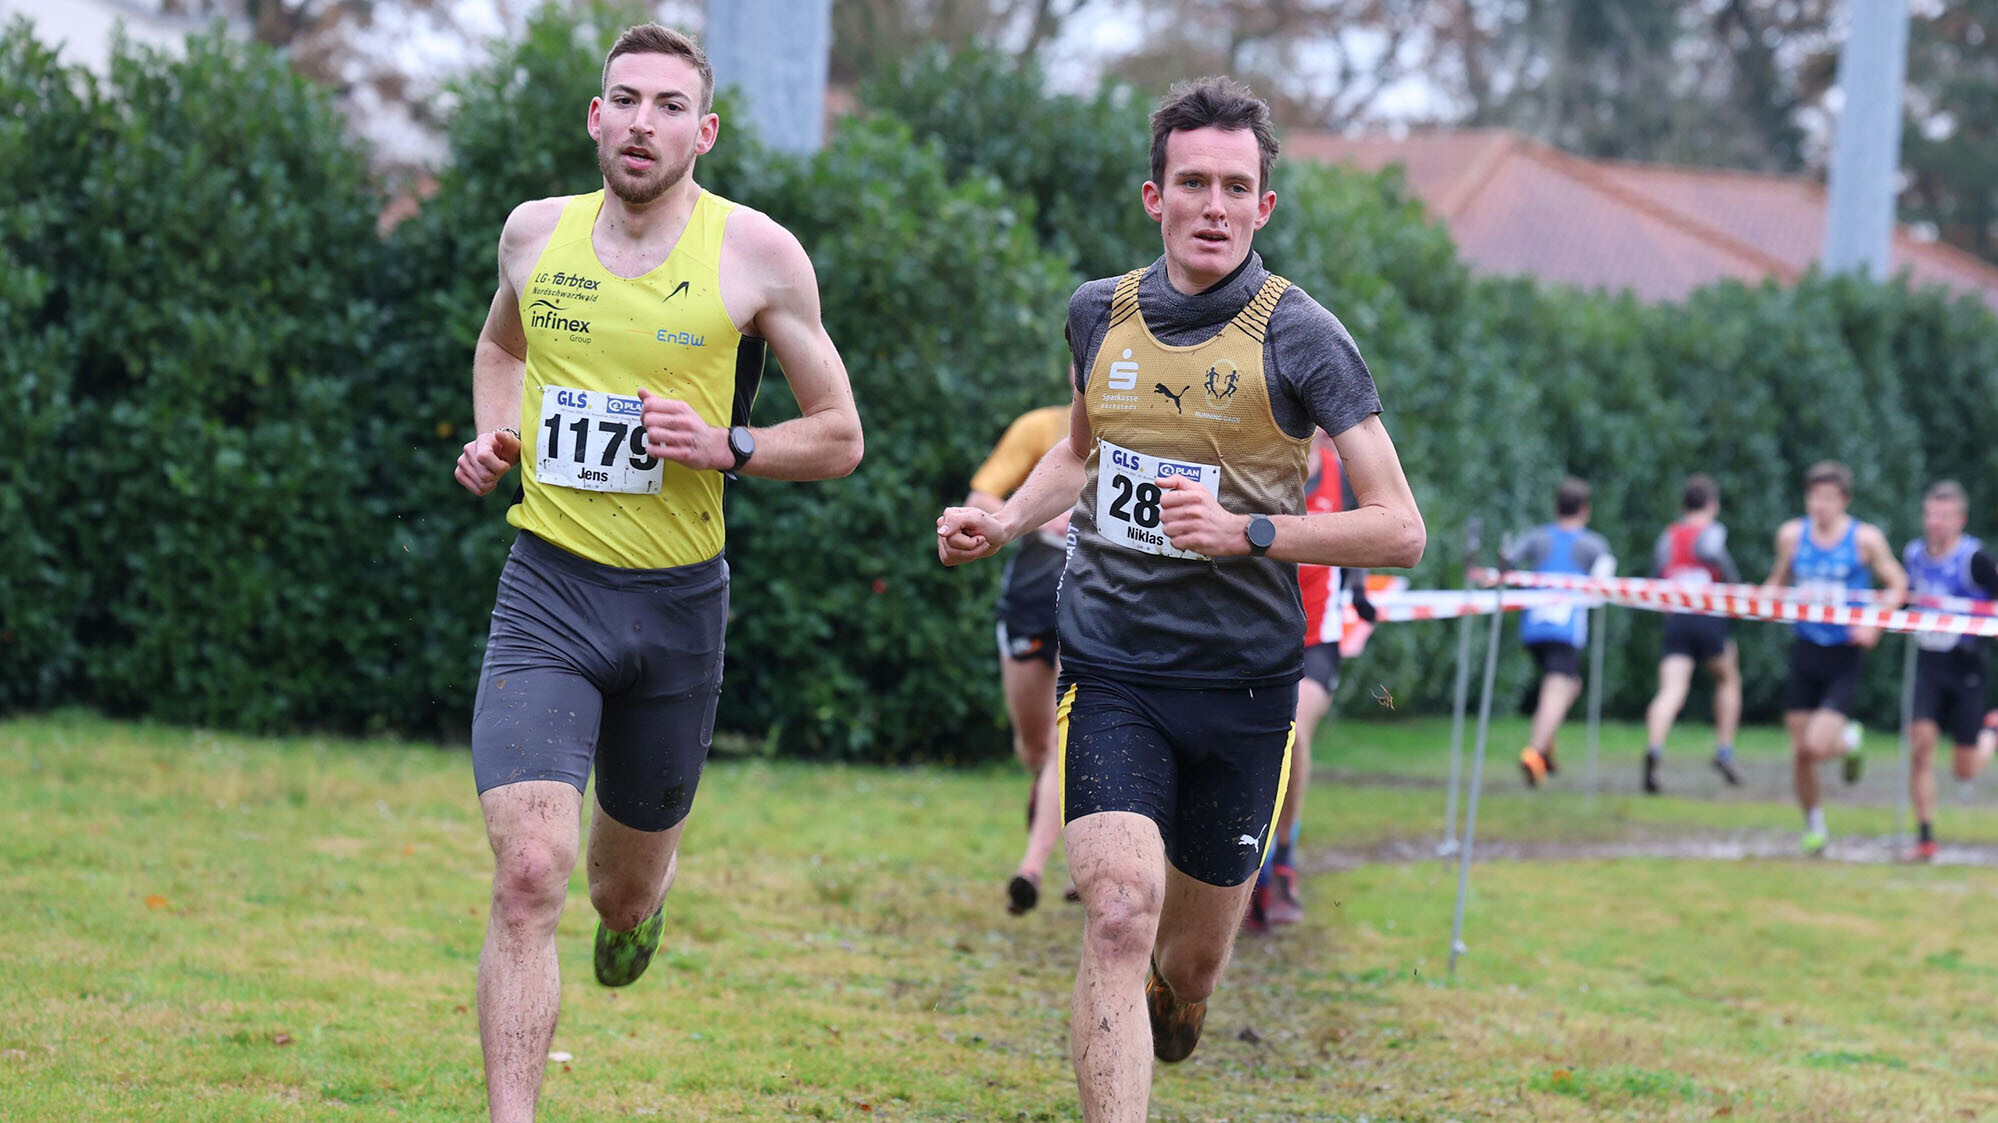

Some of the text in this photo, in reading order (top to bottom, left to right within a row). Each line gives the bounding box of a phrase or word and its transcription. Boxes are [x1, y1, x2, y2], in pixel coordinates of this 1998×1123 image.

[532, 287, 599, 302] Nordschwarzwald
[531, 310, 591, 333] infinex
[569, 334, 592, 344] Group
[656, 328, 705, 347] EnBW
[1102, 393, 1139, 402] Sparkasse
[624, 402, 645, 412] PLA
[577, 467, 609, 482] Jens
[1175, 467, 1200, 477] PLAN
[1127, 526, 1164, 546] Niklas
